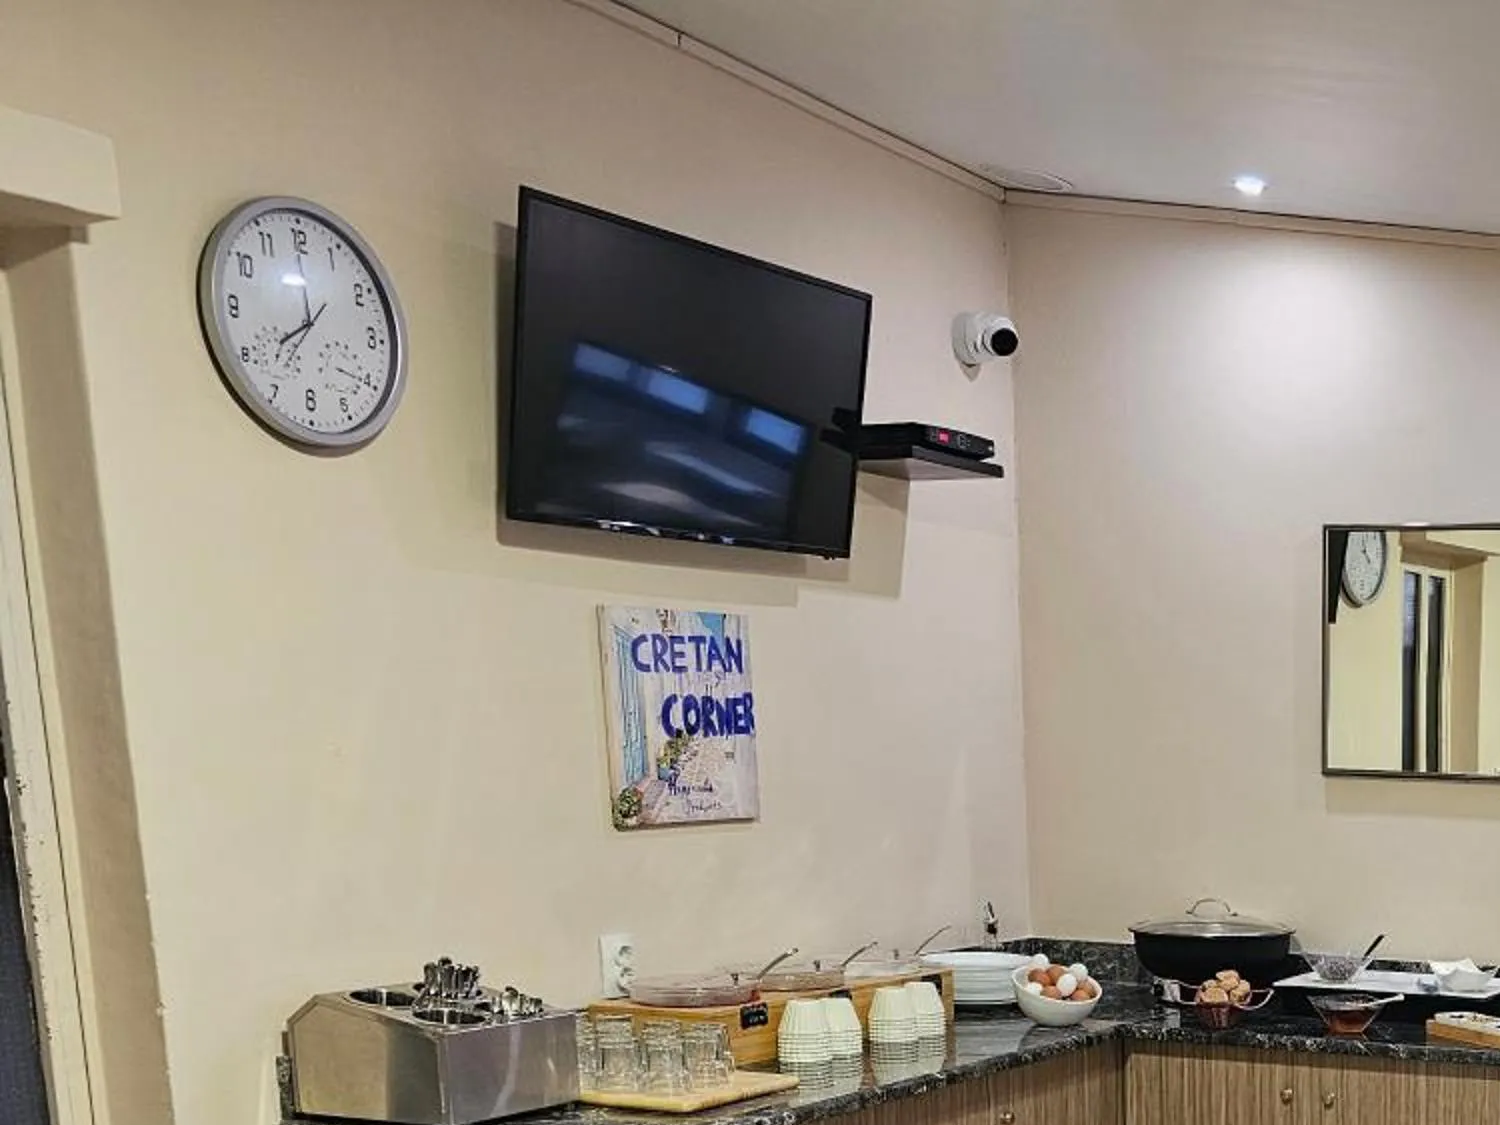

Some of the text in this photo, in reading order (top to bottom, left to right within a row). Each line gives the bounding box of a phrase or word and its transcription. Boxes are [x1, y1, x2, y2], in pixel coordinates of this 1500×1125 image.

[258, 231, 275, 258] 11
[289, 227, 309, 255] 12
[236, 251, 254, 279] 10
[327, 247, 336, 272] 1
[227, 294, 240, 318] 9
[353, 283, 364, 307] 2
[367, 326, 377, 350] 3
[630, 633, 744, 674] CRETAN
[661, 691, 756, 738] CORNER
